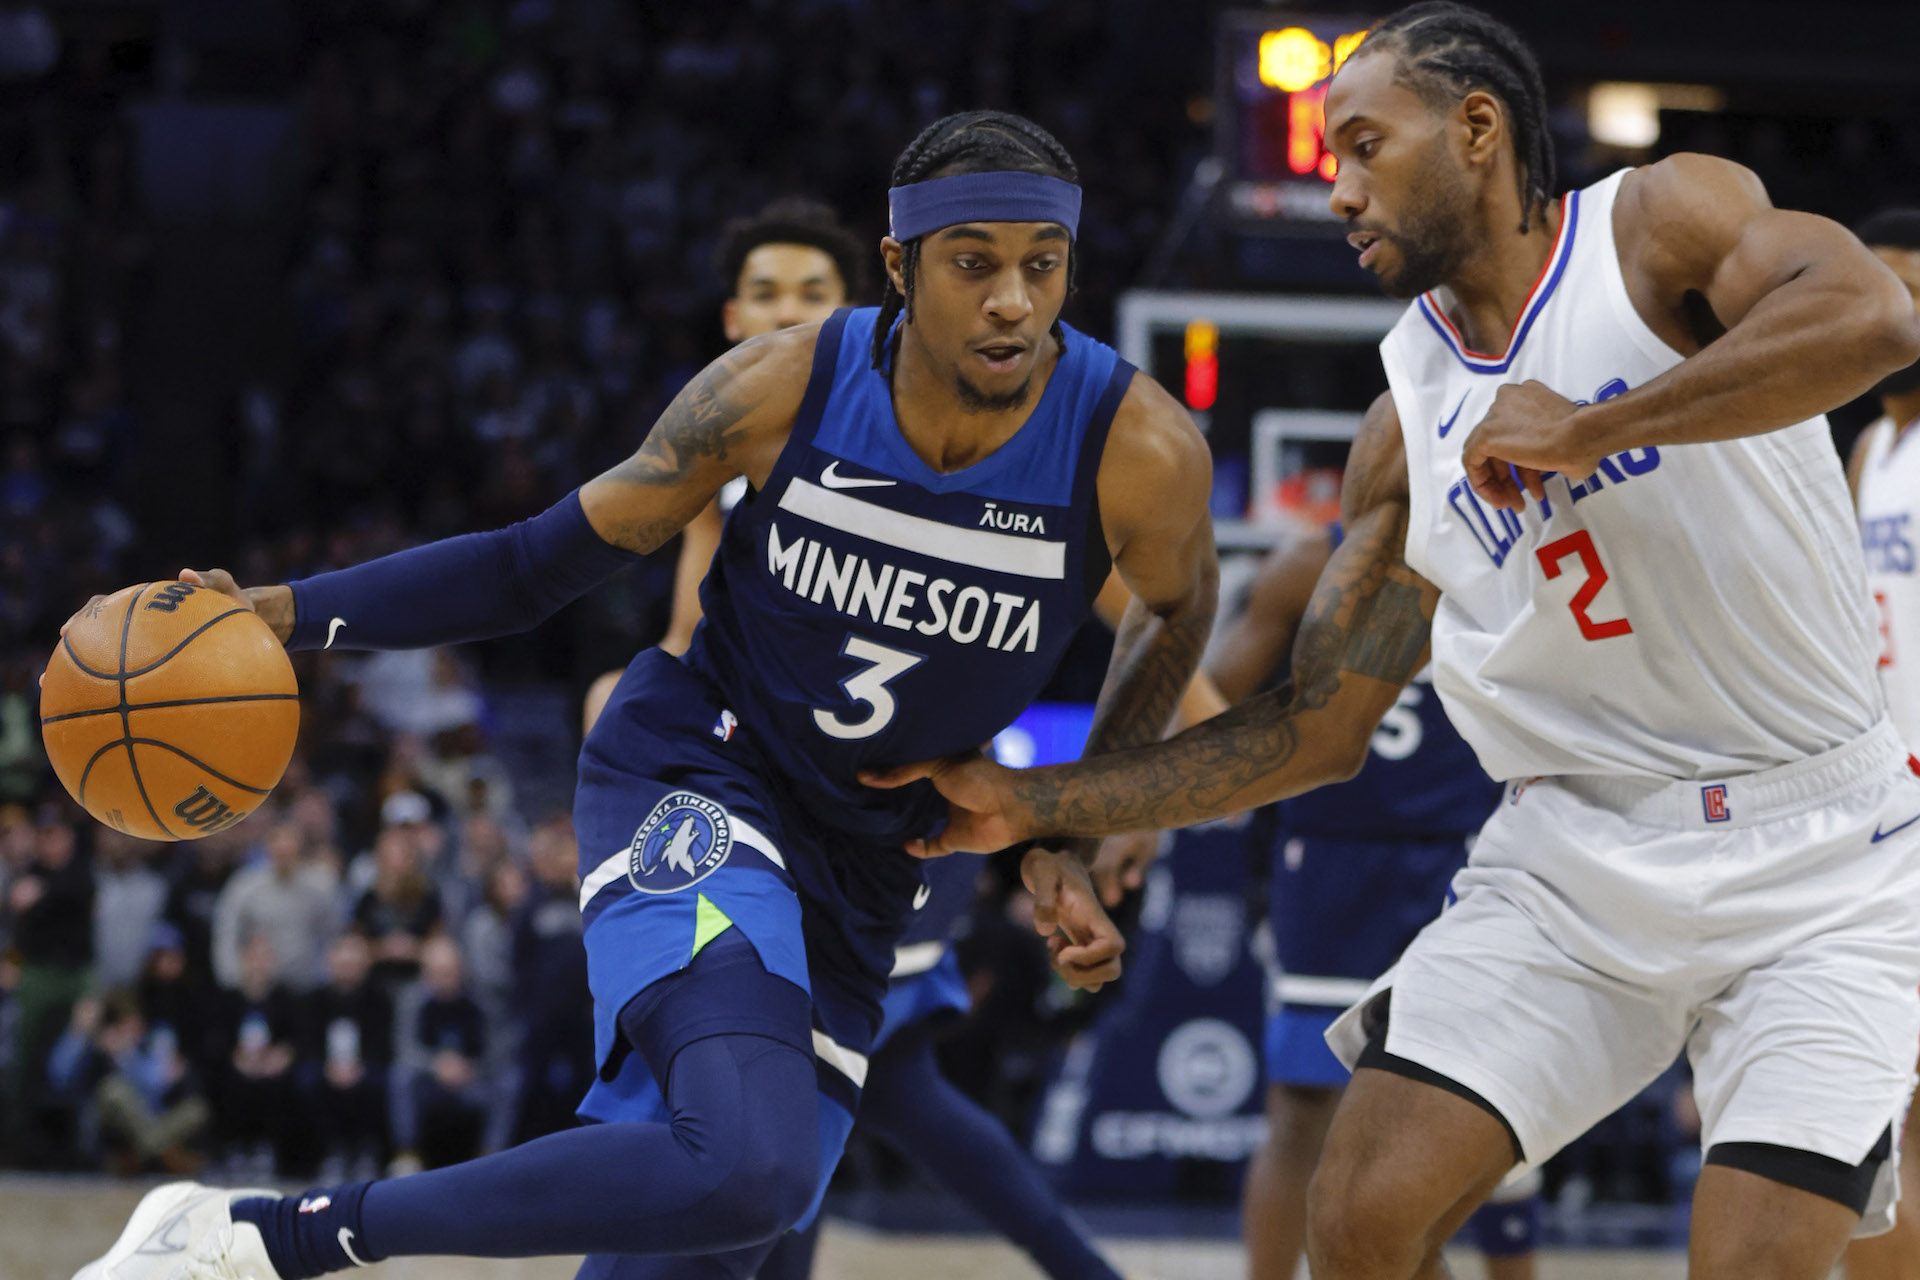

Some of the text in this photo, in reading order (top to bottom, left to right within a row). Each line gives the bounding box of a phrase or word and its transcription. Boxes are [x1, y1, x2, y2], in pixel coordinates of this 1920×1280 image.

[767, 522, 1040, 654] MINNESOTA
[1535, 529, 1633, 642] 2
[812, 632, 929, 741] 3
[631, 796, 728, 875] MINNESOTA TIMBERWOLVES
